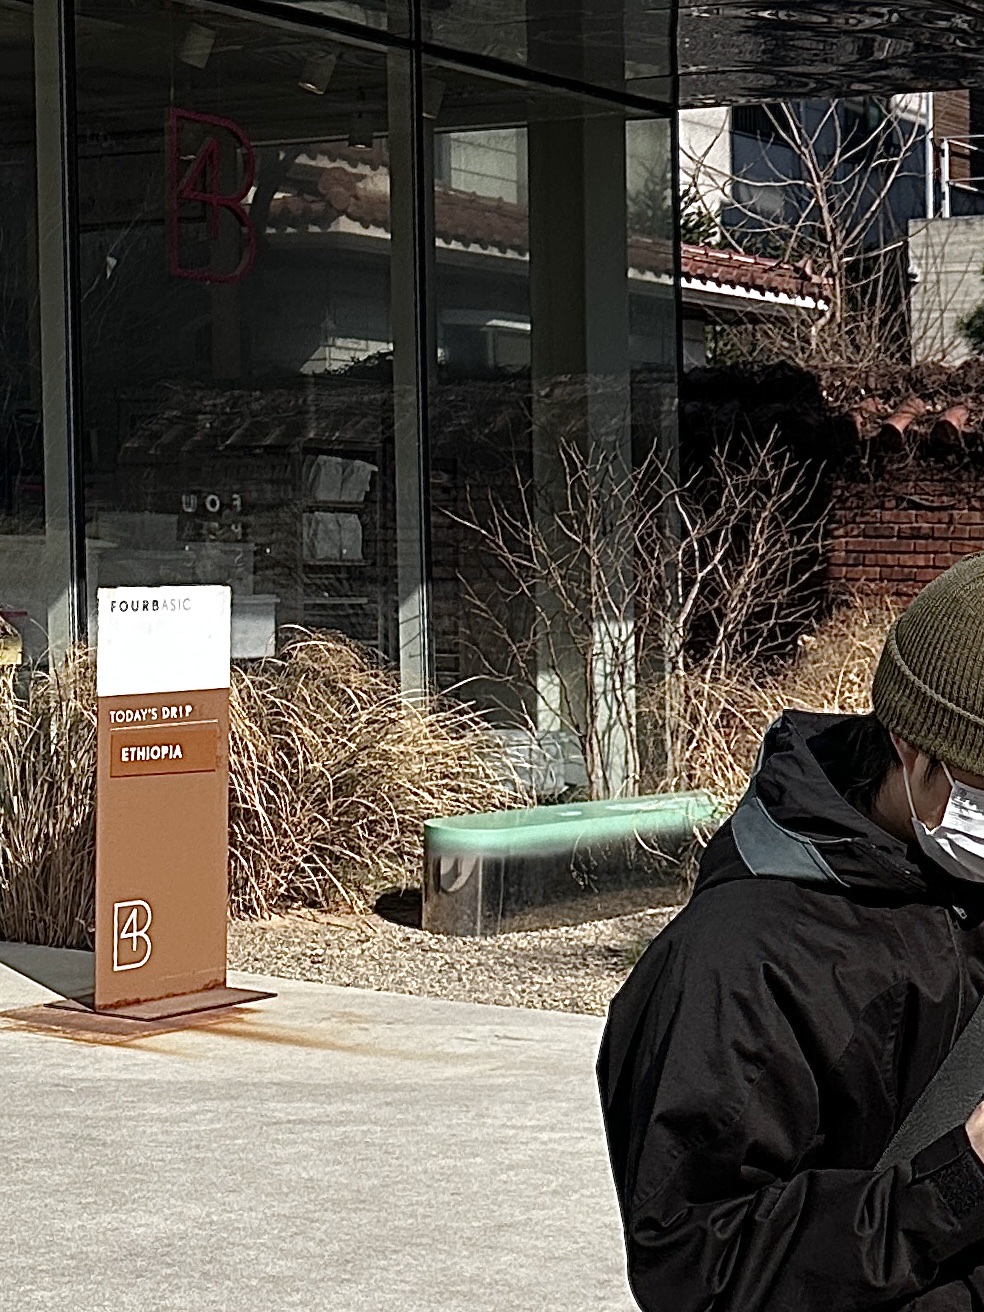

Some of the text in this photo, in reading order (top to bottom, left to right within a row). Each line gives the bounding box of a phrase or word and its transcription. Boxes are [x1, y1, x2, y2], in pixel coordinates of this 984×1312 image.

[110, 598, 191, 612] FOURBASIC
[109, 705, 193, 723] TODAY'S DRIP
[121, 744, 183, 761] ETHIOPIA
